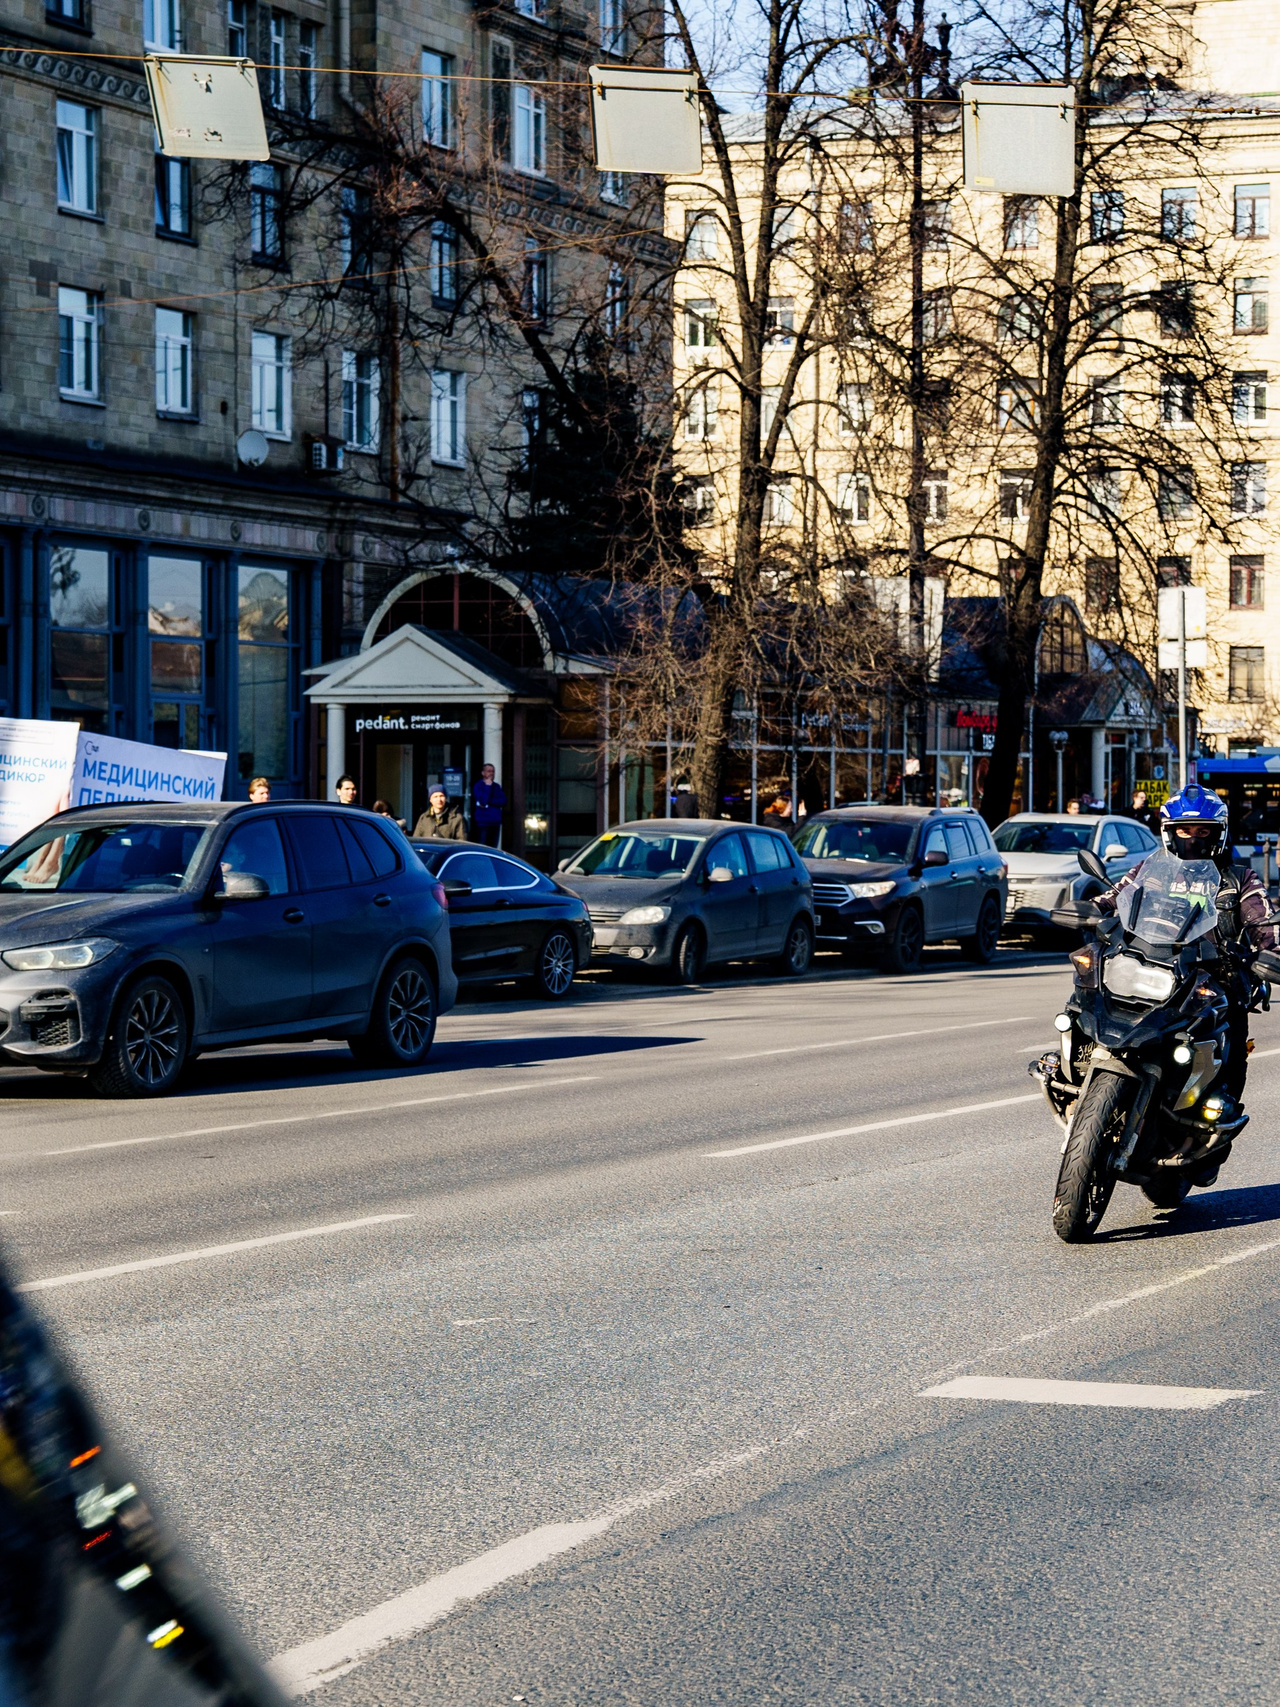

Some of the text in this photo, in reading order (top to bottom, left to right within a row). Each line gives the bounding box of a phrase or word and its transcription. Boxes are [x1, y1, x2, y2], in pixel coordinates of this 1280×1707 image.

[411, 722, 461, 730] смартфонов
[0, 754, 67, 770] ЦИНСКИЙ
[82, 758, 215, 801] МЕДИЦИНСКИЙ
[1137, 781, 1169, 793] ТАБАК
